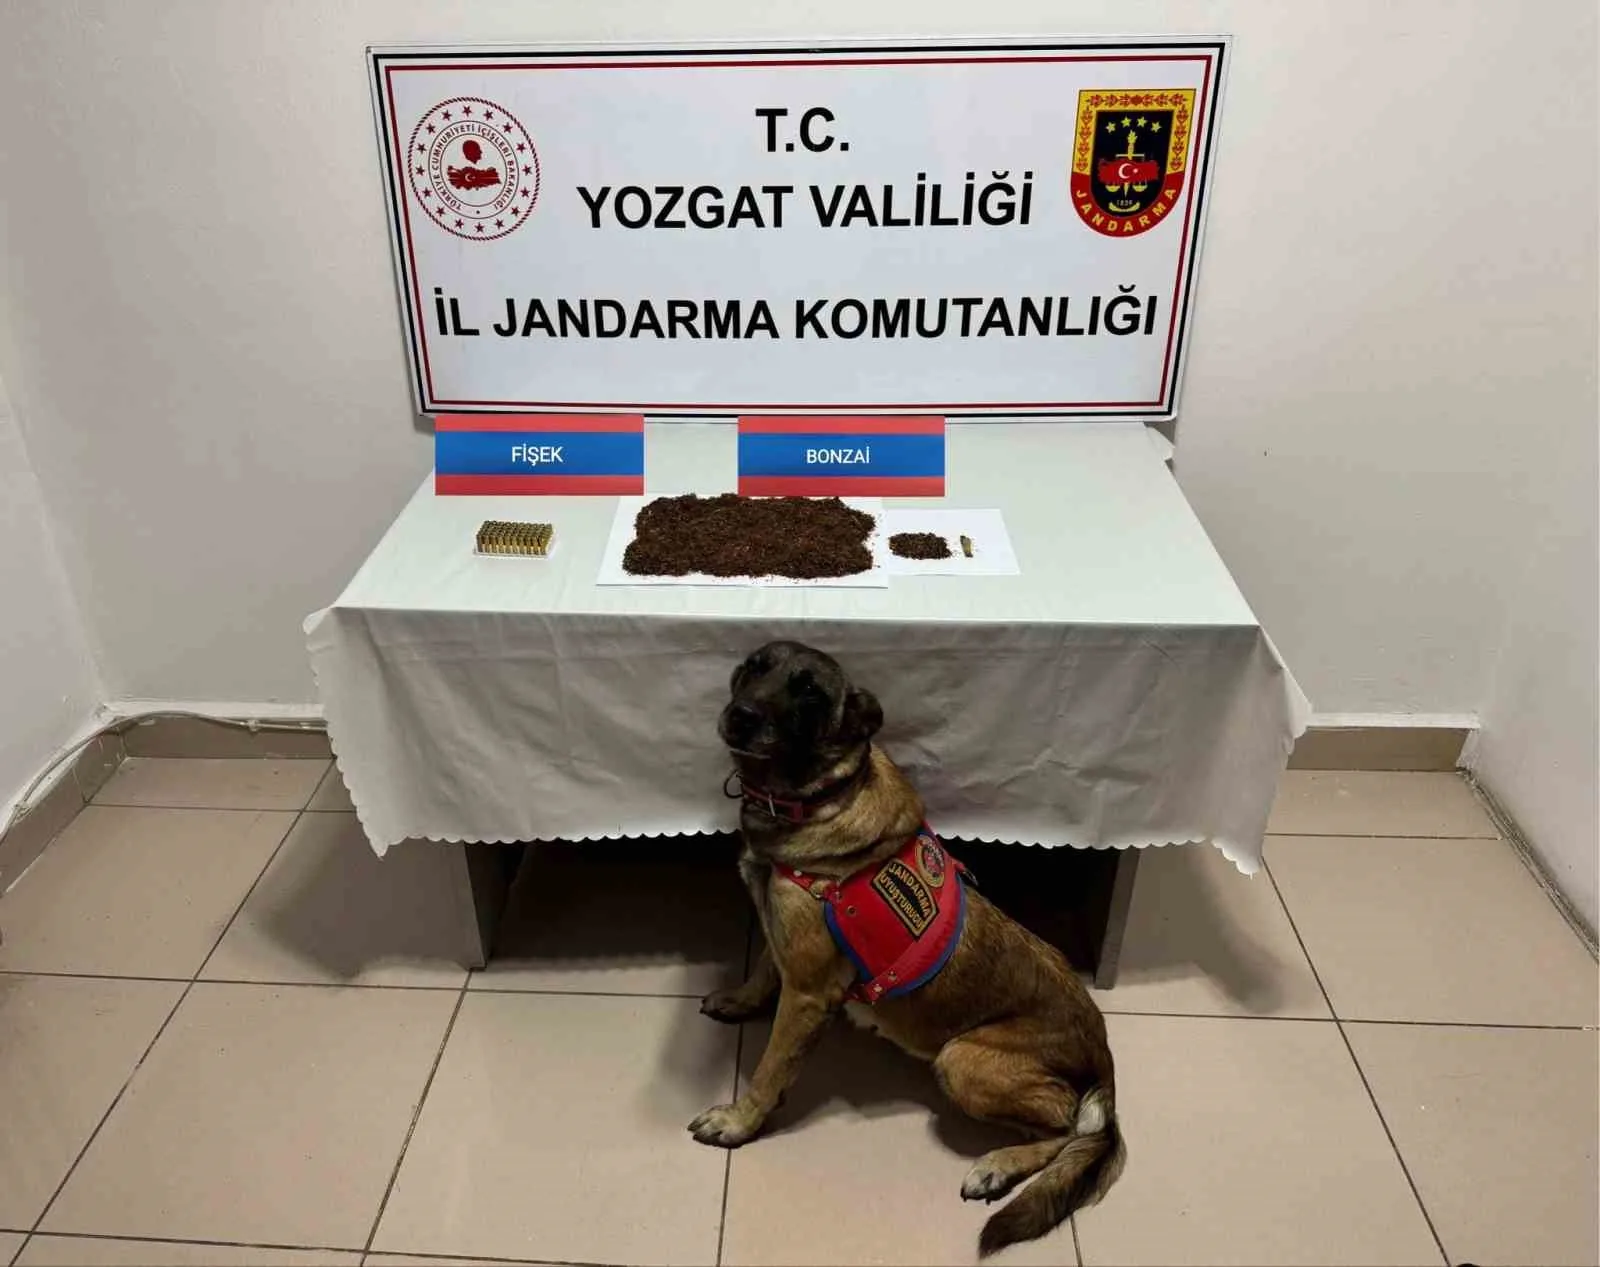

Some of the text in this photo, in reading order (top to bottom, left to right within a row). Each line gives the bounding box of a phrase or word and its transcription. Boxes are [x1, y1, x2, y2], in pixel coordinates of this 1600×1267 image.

[431, 123, 476, 172] CUMHURİYETİ
[477, 123, 512, 158] İÇİŞLERİ
[755, 107, 849, 153] T.C.
[576, 170, 1033, 230] YOZGAT VALİLİĞİ
[1076, 189, 1176, 232] JANDARMA
[433, 284, 1158, 340] İL JANDARMA KOMUTANLIĞI
[888, 863, 931, 918] JANDARMA
